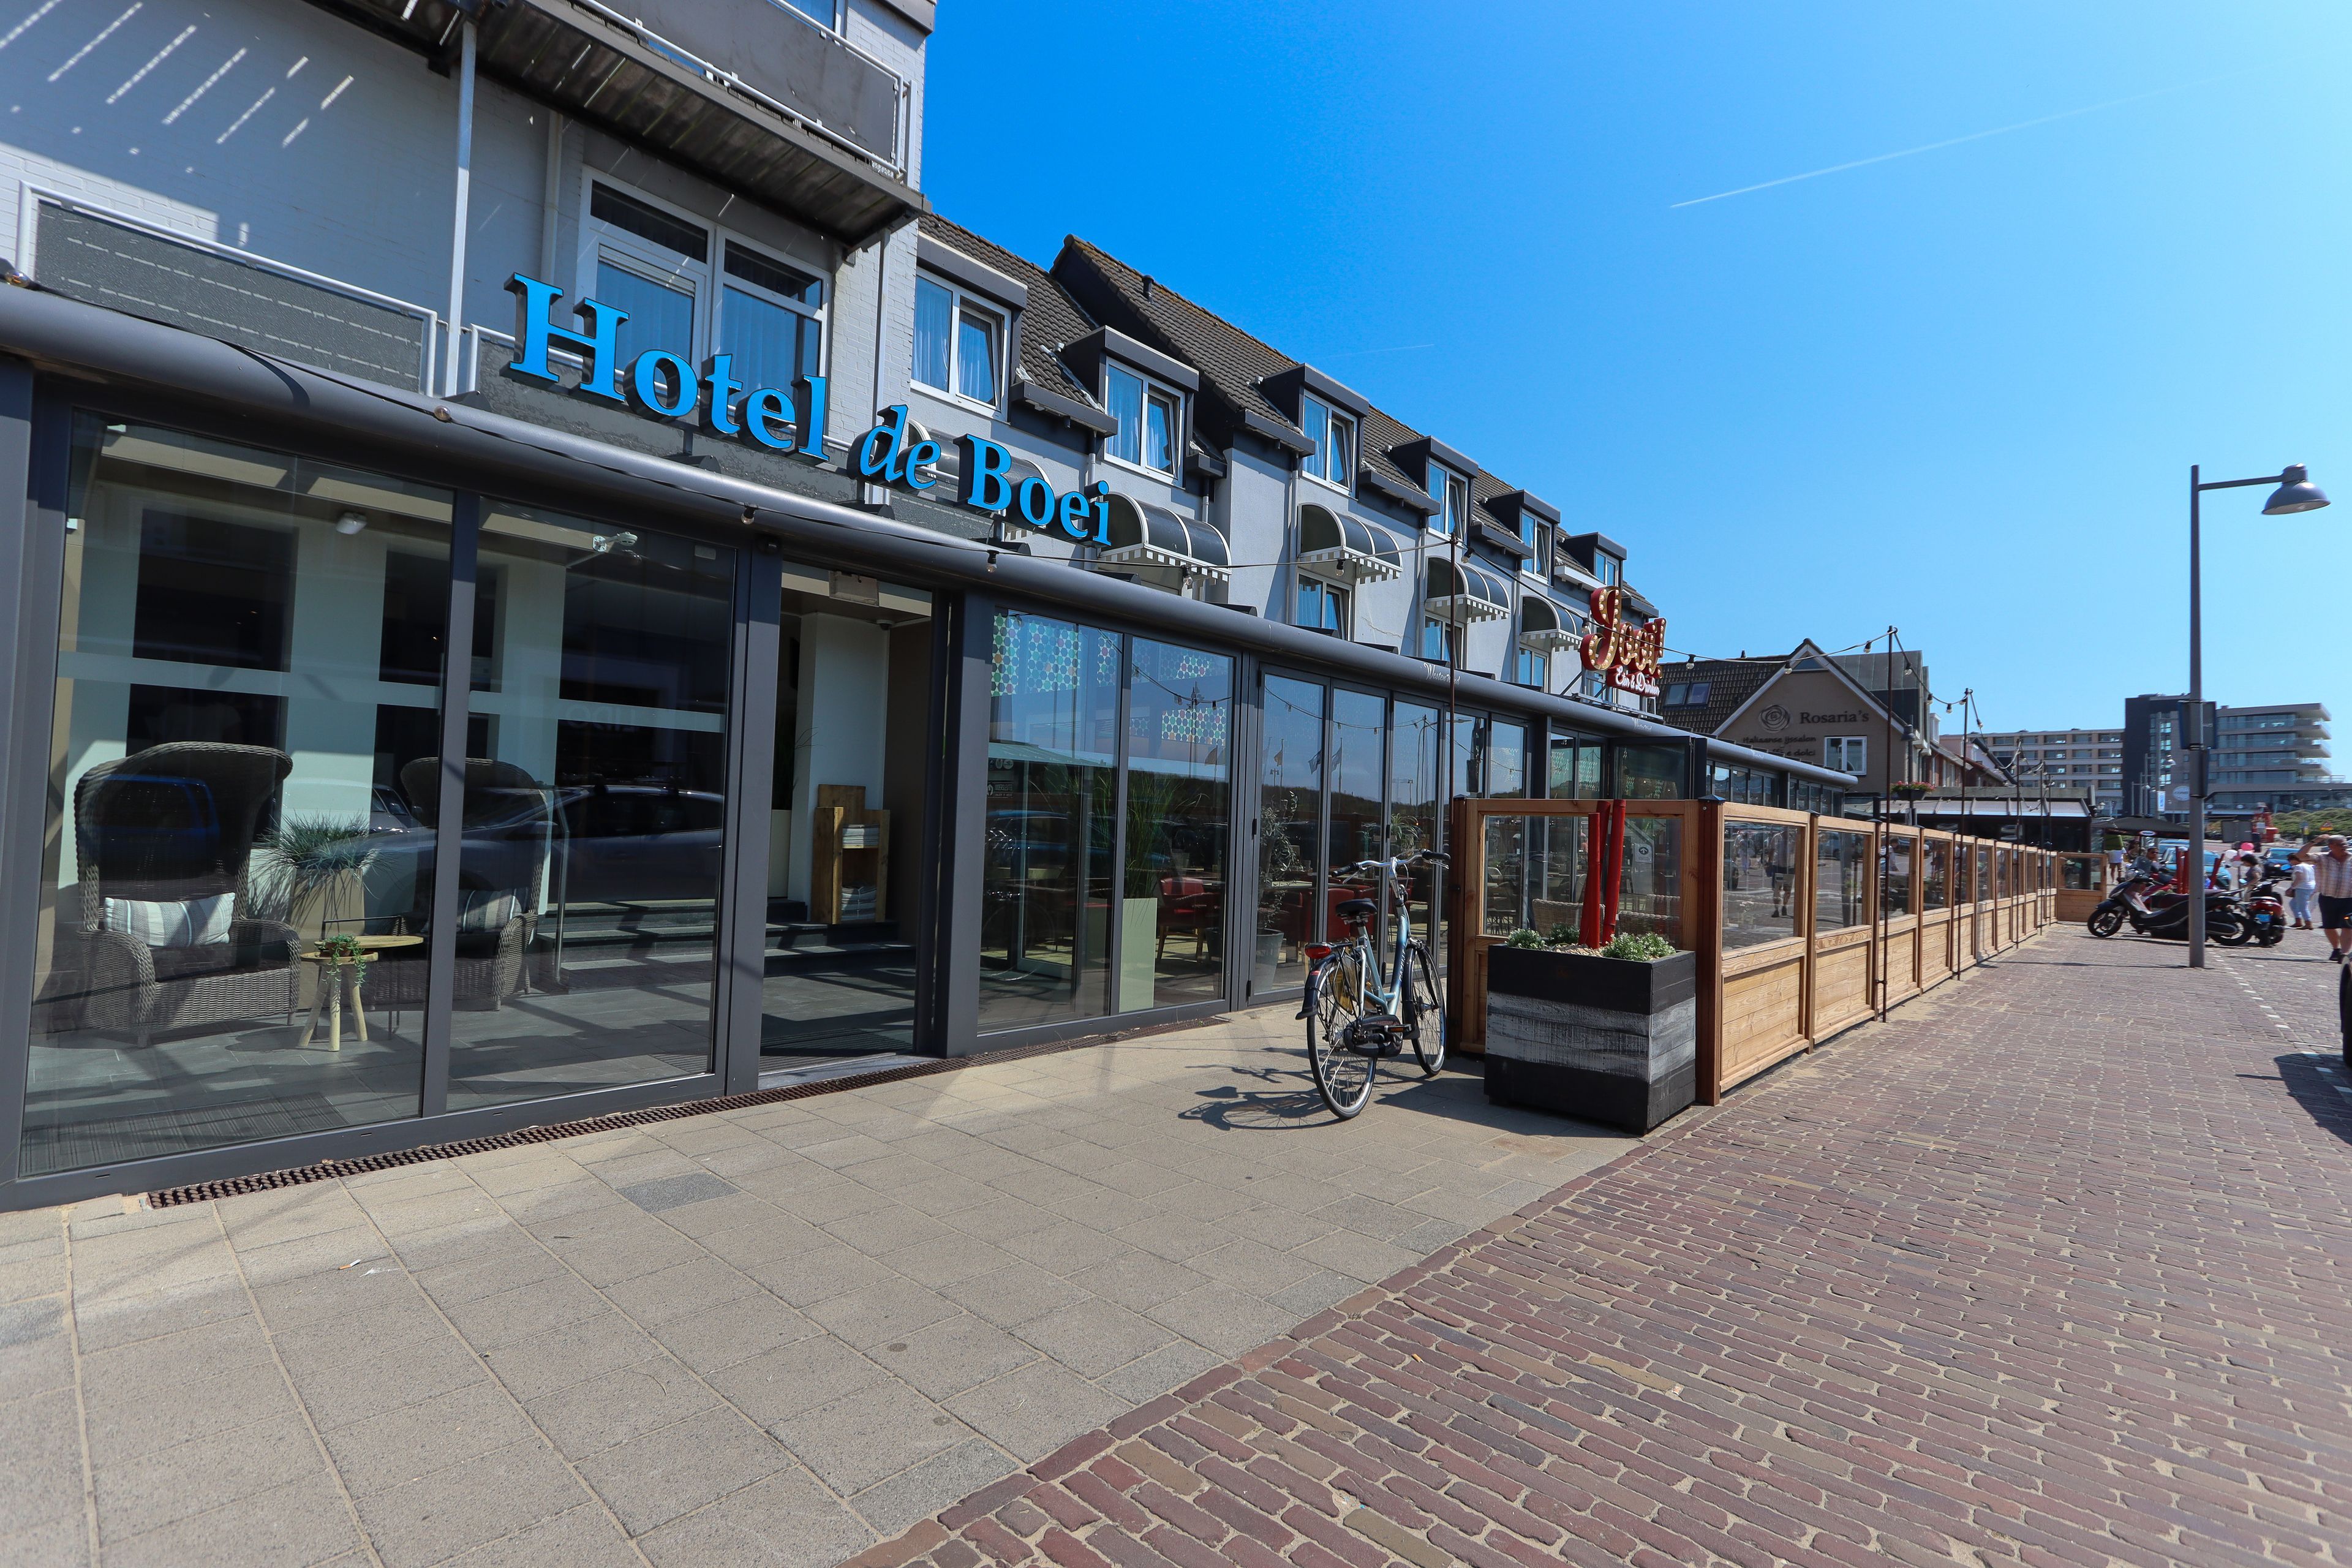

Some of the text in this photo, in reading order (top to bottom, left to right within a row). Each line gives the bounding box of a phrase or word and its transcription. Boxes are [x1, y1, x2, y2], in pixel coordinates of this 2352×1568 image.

[510, 273, 1112, 547] Hotel de Boei
[1800, 710, 1870, 724] Rosaria's
